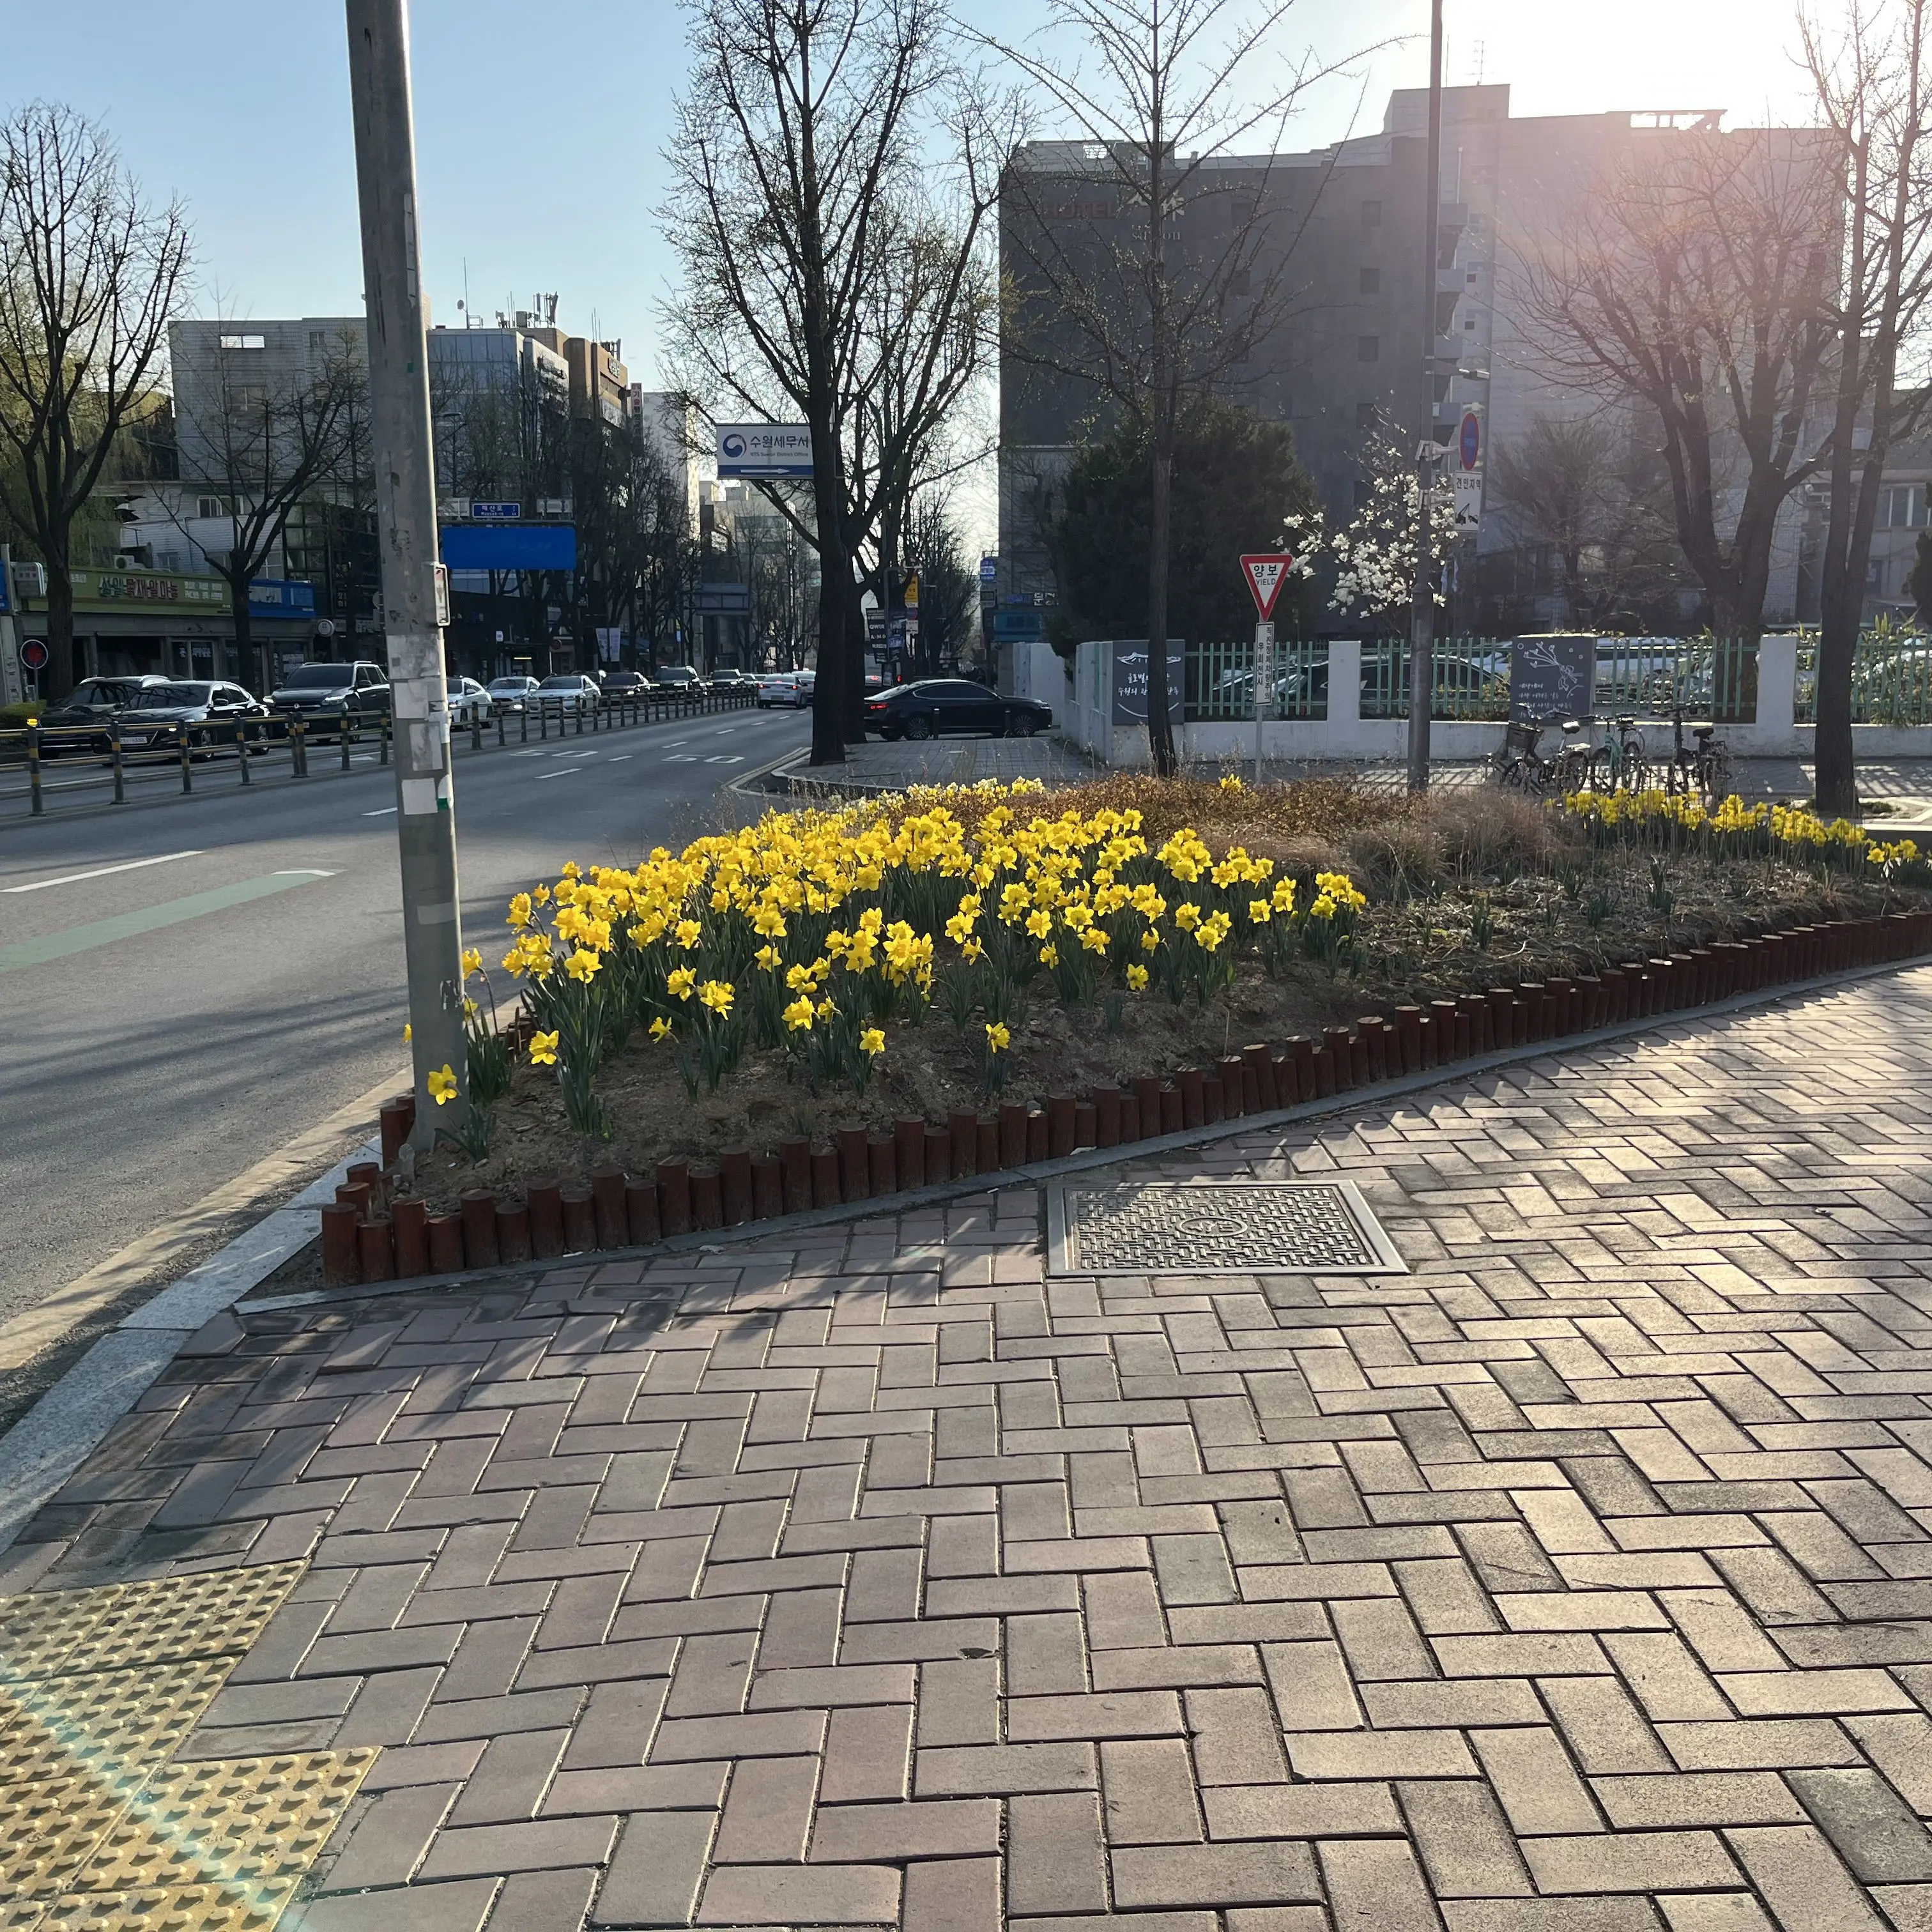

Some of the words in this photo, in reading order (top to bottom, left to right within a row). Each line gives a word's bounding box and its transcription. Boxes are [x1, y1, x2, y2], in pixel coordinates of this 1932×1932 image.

[1043, 201, 1117, 219] HOTEL
[1131, 231, 1181, 241] suon
[749, 436, 809, 448] 수원세무서
[1456, 477, 1481, 490] 견인지역
[1254, 564, 1278, 578] 양보
[1118, 687, 1138, 696] 수원의
[509, 749, 599, 758] 50
[661, 754, 746, 763] 50
